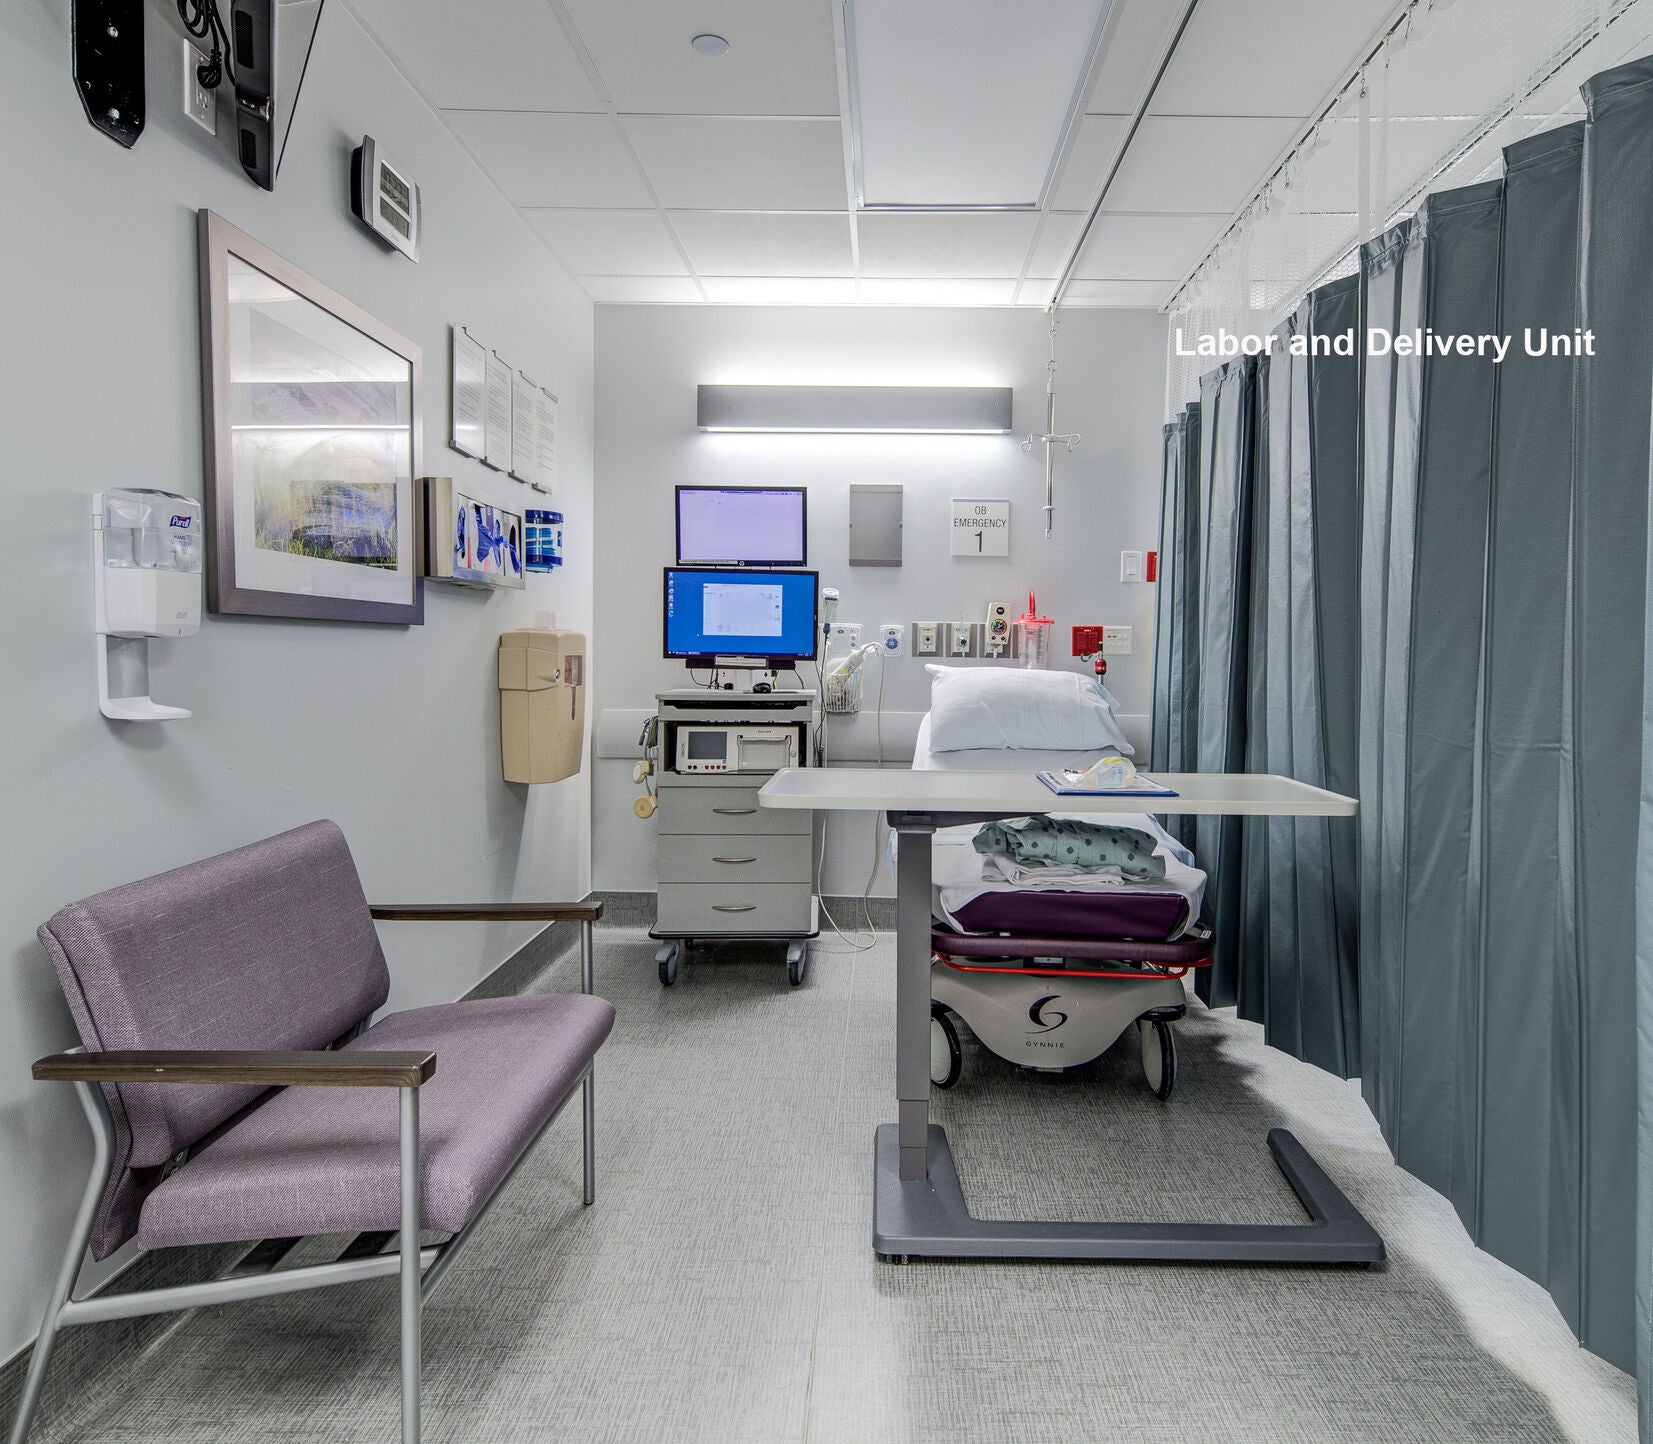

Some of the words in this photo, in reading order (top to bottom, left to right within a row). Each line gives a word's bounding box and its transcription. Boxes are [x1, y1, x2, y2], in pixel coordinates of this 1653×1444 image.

[975, 506, 986, 515] OB
[954, 518, 1007, 528] EMERGENCY
[975, 531, 982, 552] 1
